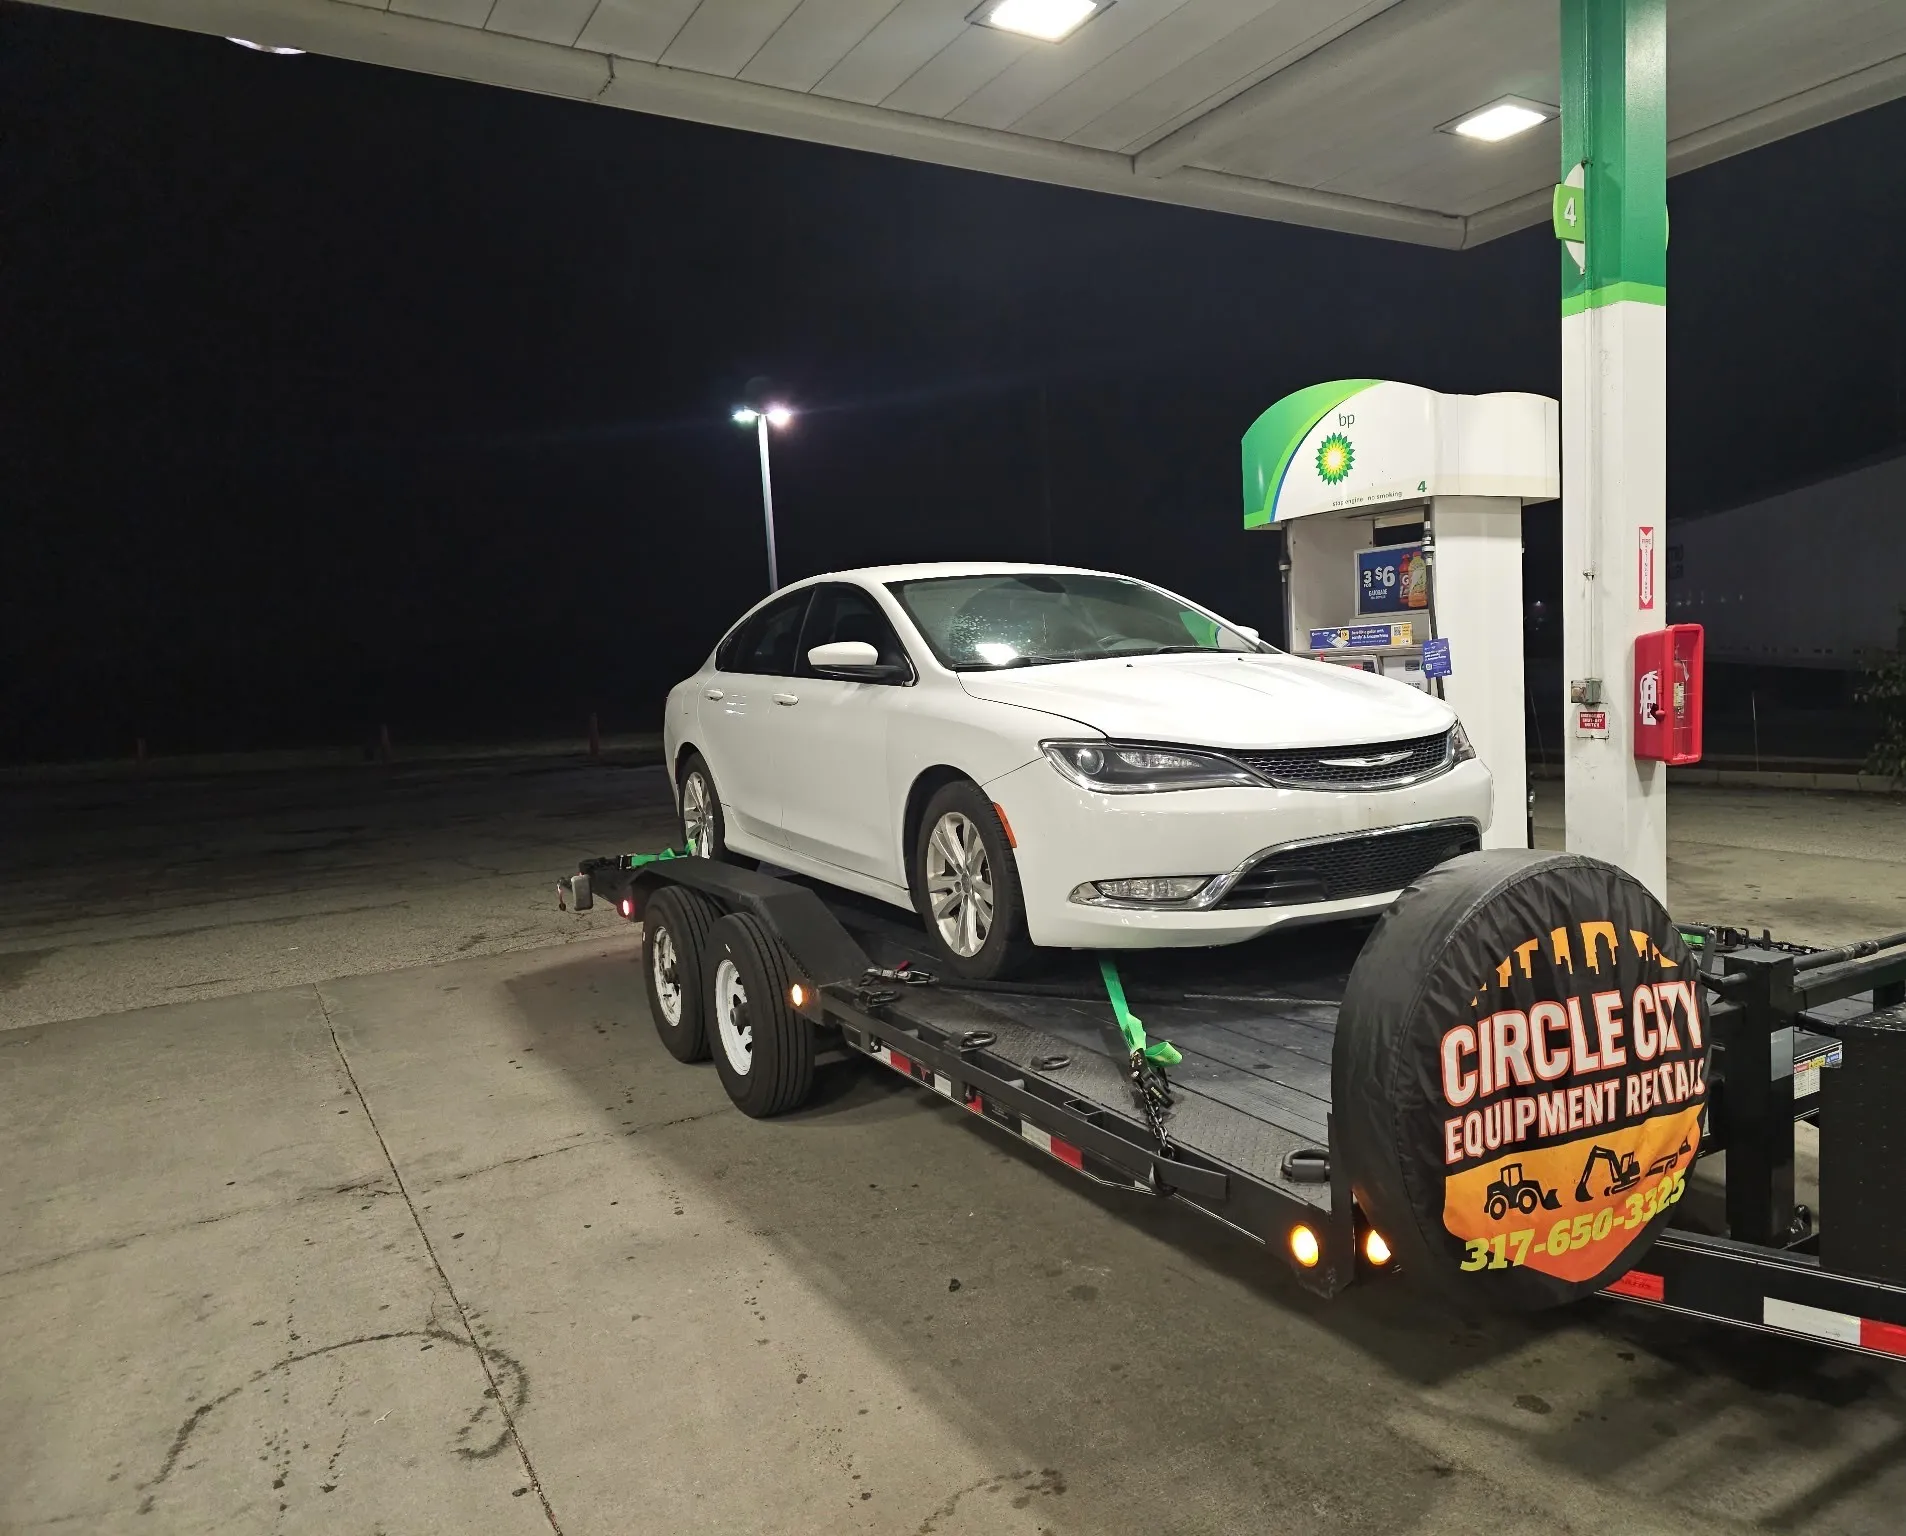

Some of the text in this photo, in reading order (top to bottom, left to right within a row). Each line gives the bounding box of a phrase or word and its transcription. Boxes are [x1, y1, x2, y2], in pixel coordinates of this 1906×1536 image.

[1564, 197, 1577, 227] 4
[1339, 413, 1355, 428] bp
[1376, 491, 1403, 500] smoking
[1417, 480, 1427, 492] 4
[1363, 565, 1396, 587] 3 $6
[1441, 981, 1702, 1107] CIRCLE CITY
[1443, 1078, 1620, 1164] EQUIPMENT
[1460, 1168, 1686, 1272] 317-650-3325
